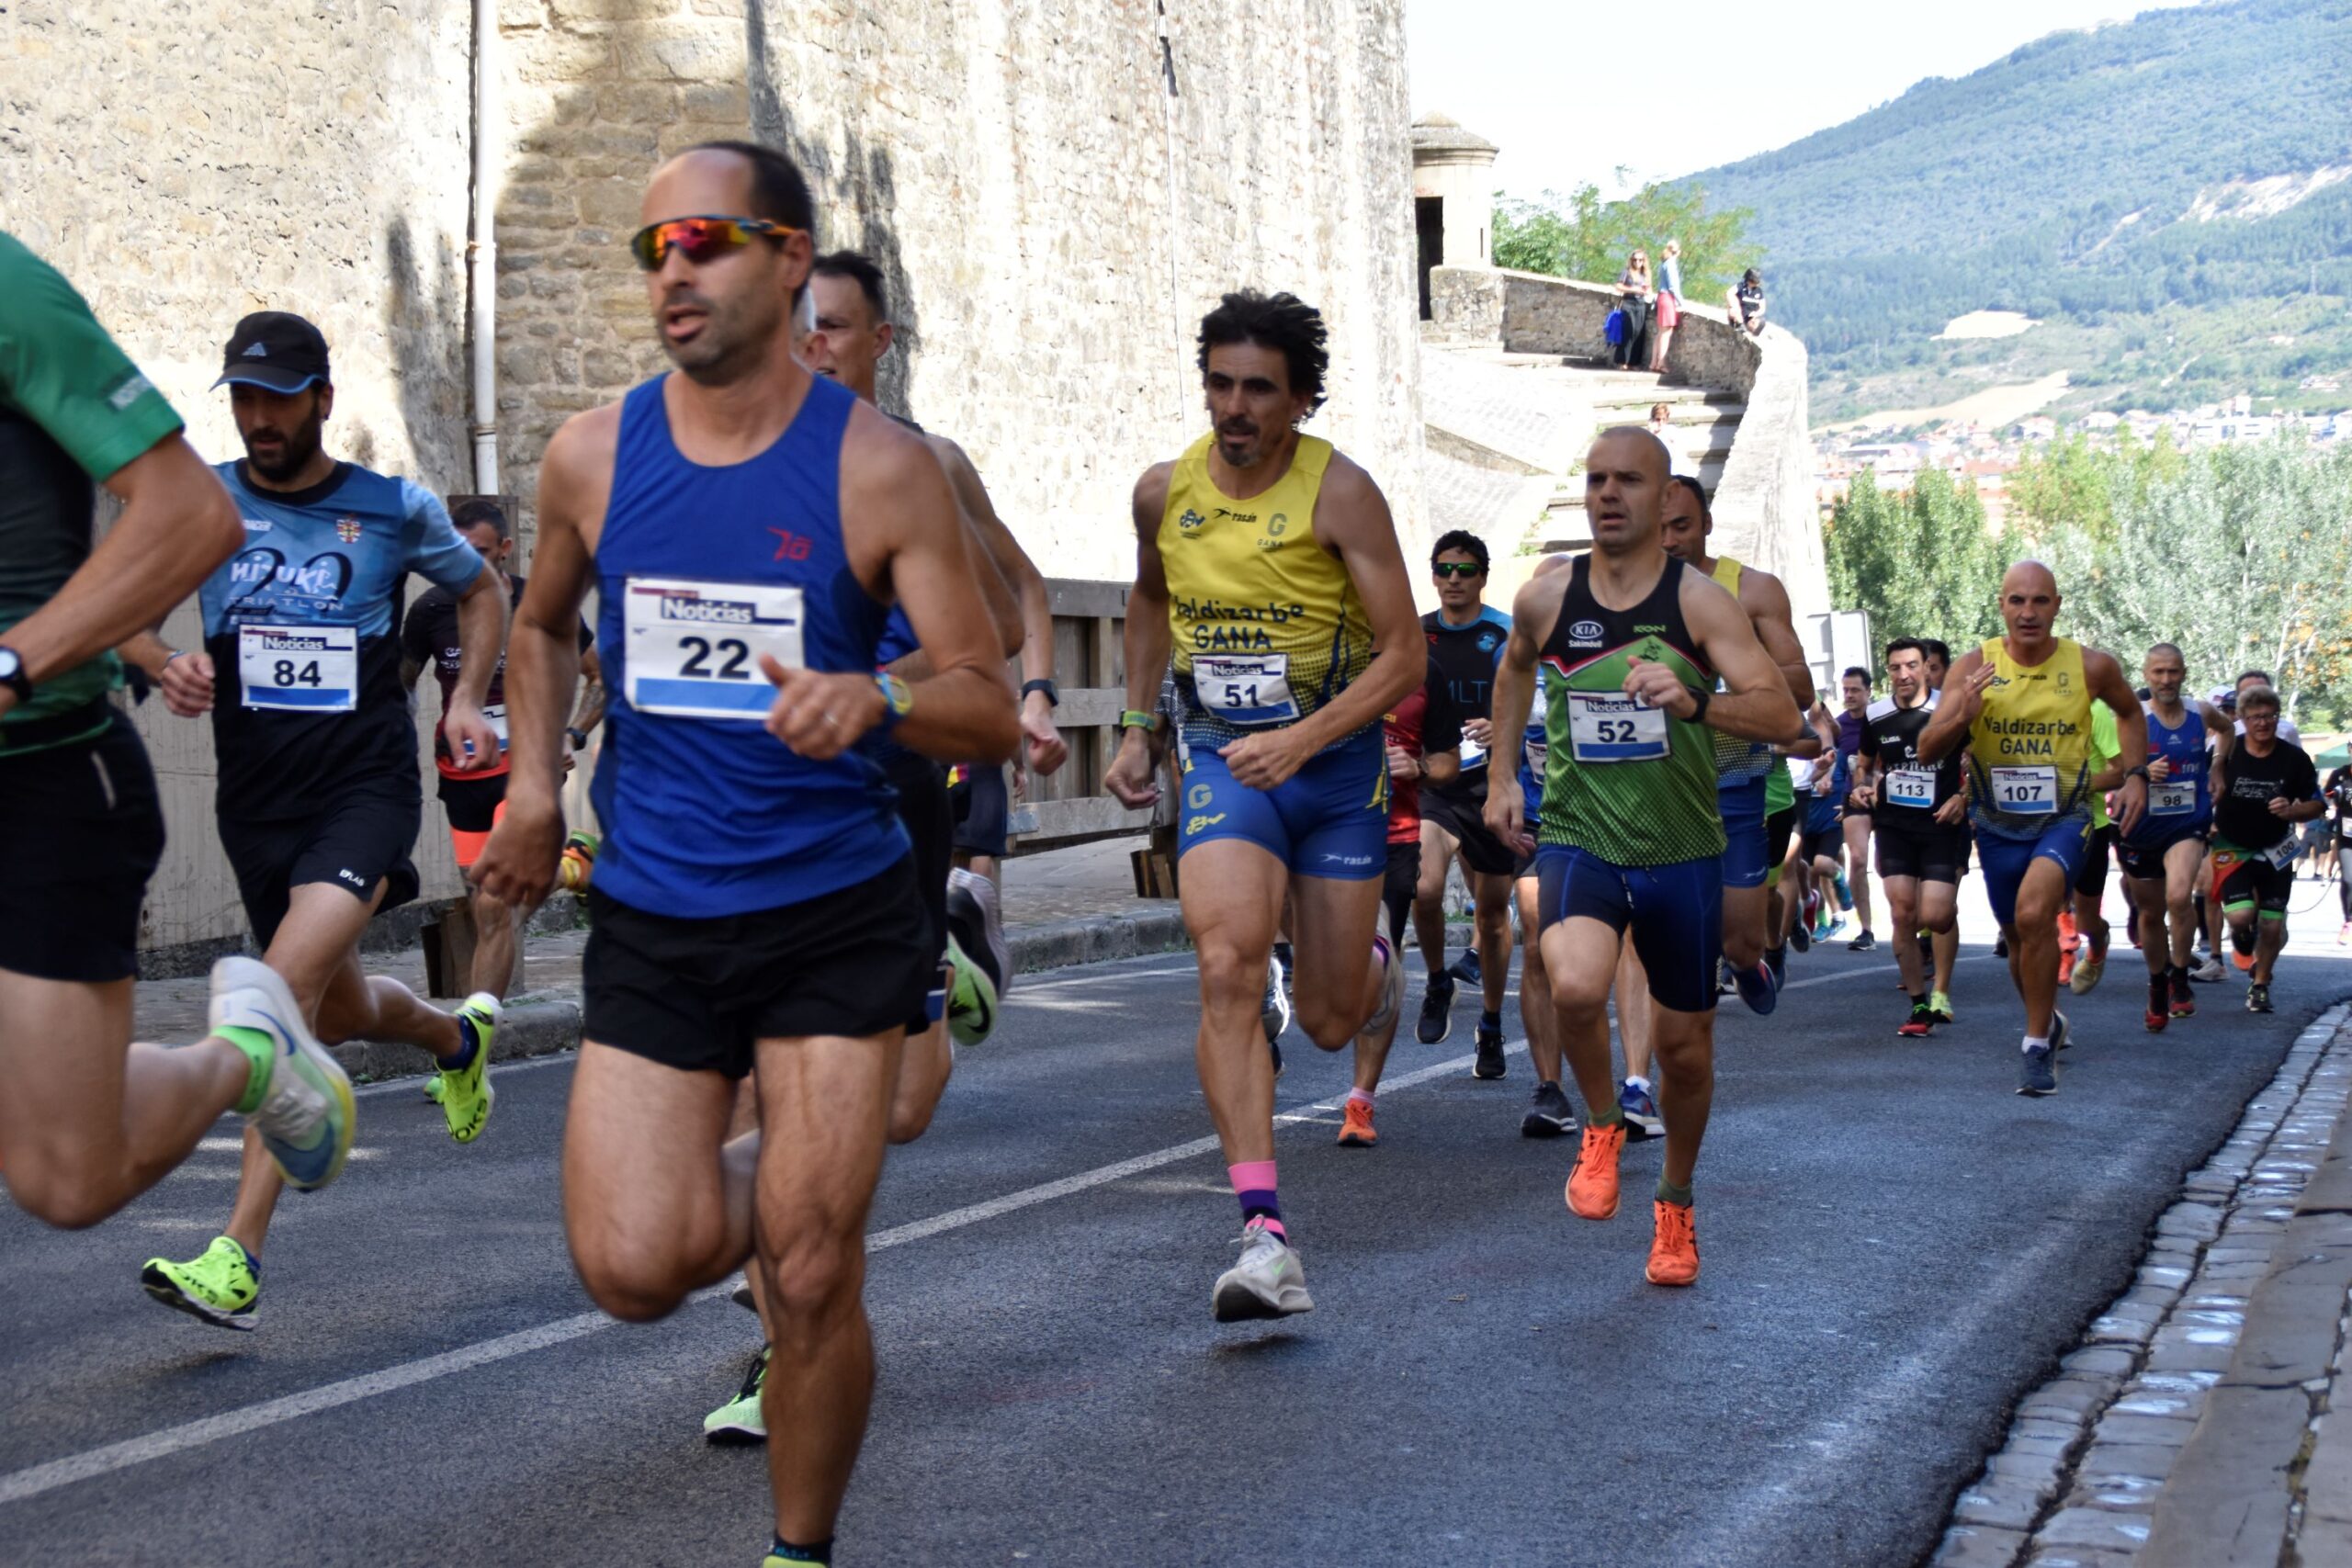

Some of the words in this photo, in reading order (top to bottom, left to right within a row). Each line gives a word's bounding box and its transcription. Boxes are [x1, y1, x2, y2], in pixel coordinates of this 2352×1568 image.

[664, 599, 751, 623] Noticias
[1194, 625, 1272, 649] GANA
[1575, 625, 1599, 636] KIA
[265, 637, 324, 650] Noticias
[678, 636, 751, 680] 22
[273, 659, 322, 688] 84
[1213, 664, 1263, 676] Noticias
[1225, 683, 1260, 708] 51
[1587, 700, 1635, 712] Noticias
[1597, 719, 1637, 743] 52
[1984, 716, 2076, 735] Valdizarbe
[1999, 738, 2052, 755] GANA
[1895, 783, 1925, 797] 113
[2004, 785, 2042, 802] 107
[2162, 795, 2182, 807] 98
[2274, 840, 2295, 859] 100
